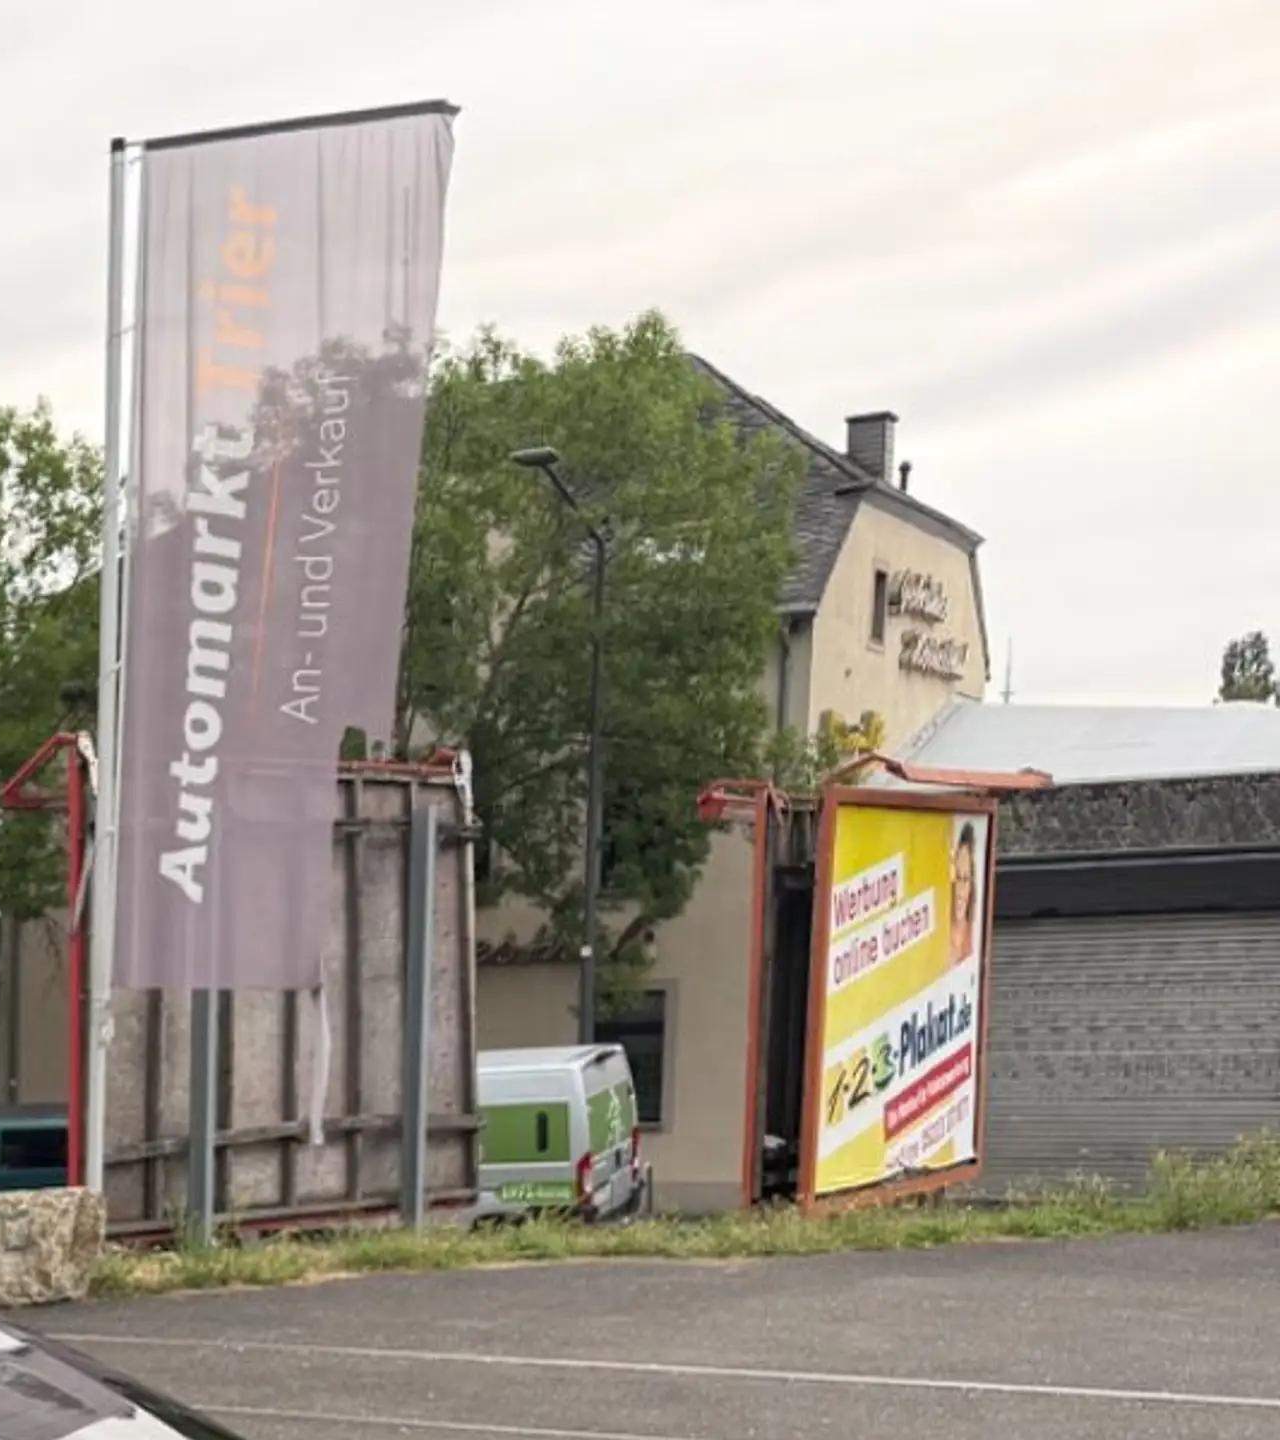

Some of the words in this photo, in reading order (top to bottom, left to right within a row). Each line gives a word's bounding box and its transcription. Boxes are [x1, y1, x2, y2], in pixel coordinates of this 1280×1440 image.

[195, 186, 278, 398] Trier
[300, 372, 354, 548] Verkauf
[295, 540, 334, 636] und
[159, 424, 255, 903] Automarkt
[279, 644, 321, 726] An-
[833, 868, 897, 928] Werbung
[833, 935, 878, 985] online
[882, 903, 929, 957] buchen
